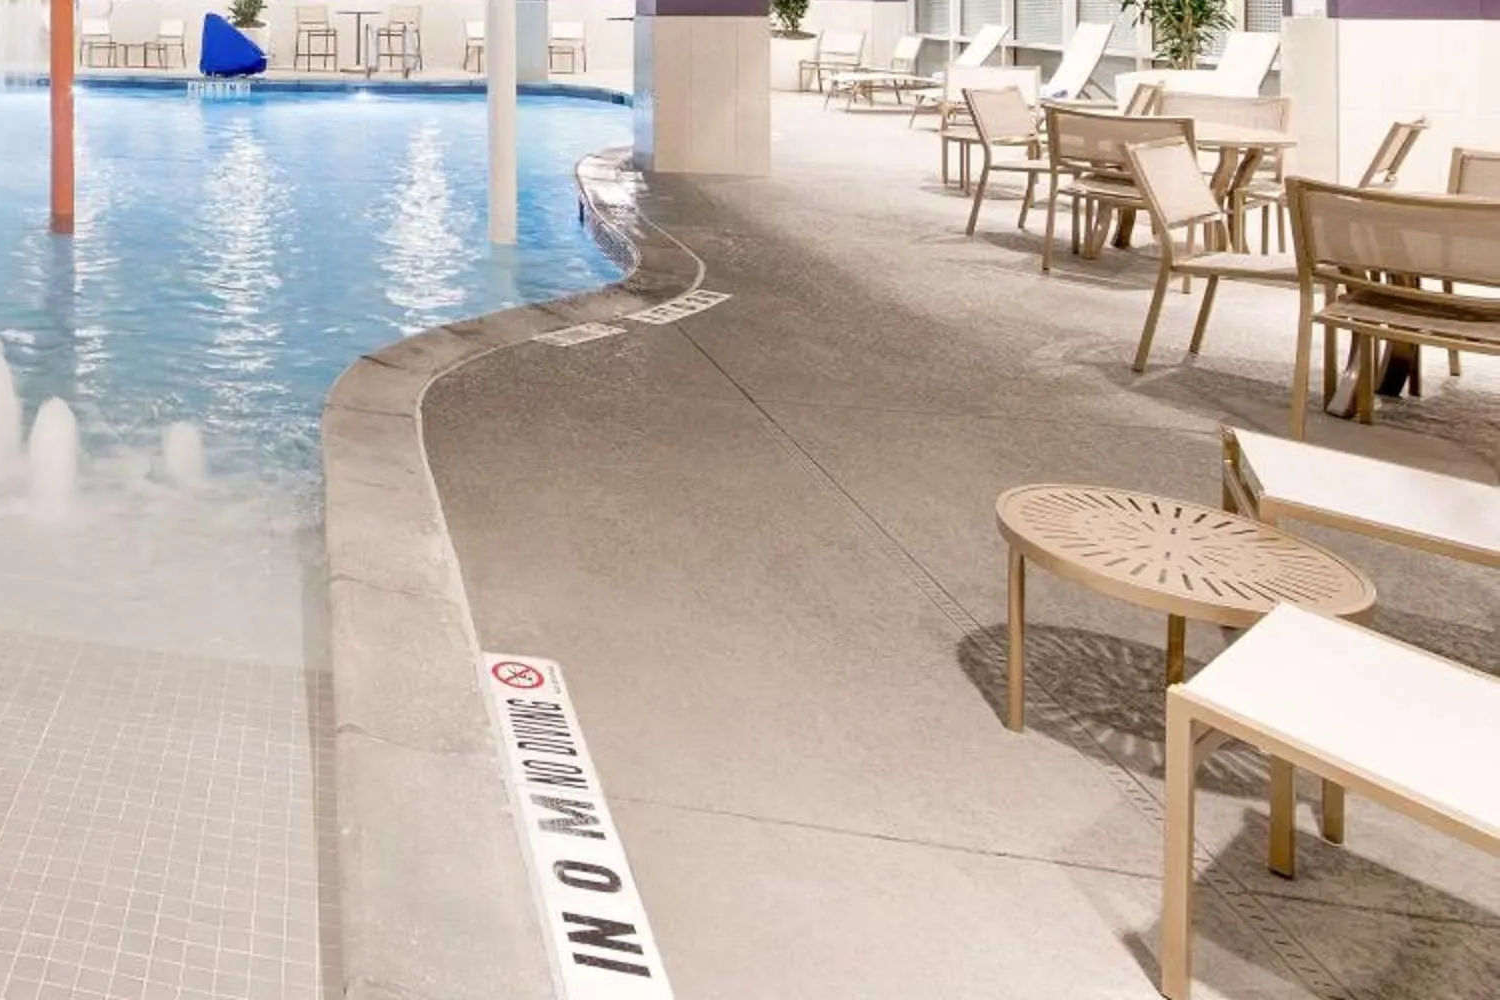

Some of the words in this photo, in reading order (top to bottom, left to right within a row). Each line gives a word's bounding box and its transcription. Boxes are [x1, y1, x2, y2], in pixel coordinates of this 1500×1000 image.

[506, 698, 577, 757] DIVING
[522, 759, 589, 790] NO
[530, 793, 606, 840] M
[561, 911, 652, 979] IN
